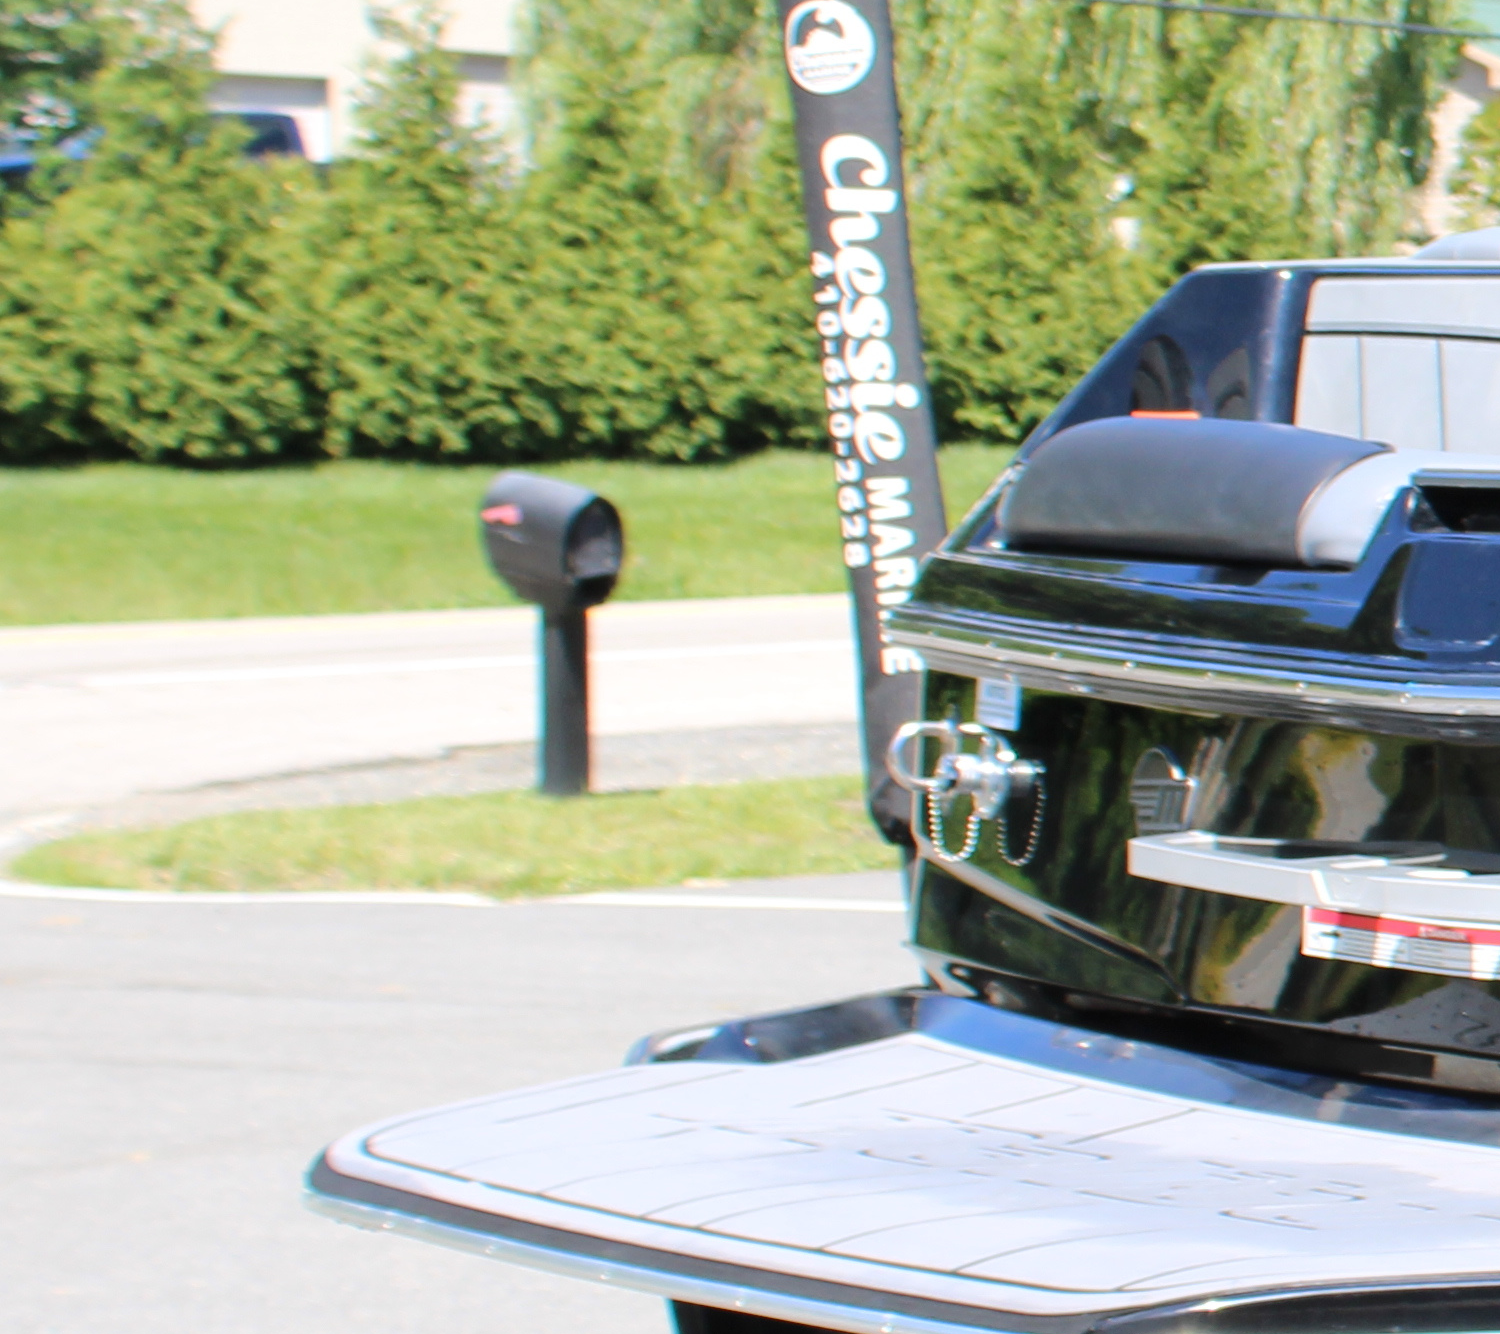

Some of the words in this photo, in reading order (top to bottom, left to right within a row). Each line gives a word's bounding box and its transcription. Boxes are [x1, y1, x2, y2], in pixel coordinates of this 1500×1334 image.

[811, 251, 871, 569] 410-620-2628
[820, 133, 921, 465] Chessie
[864, 476, 926, 676] MARIE
